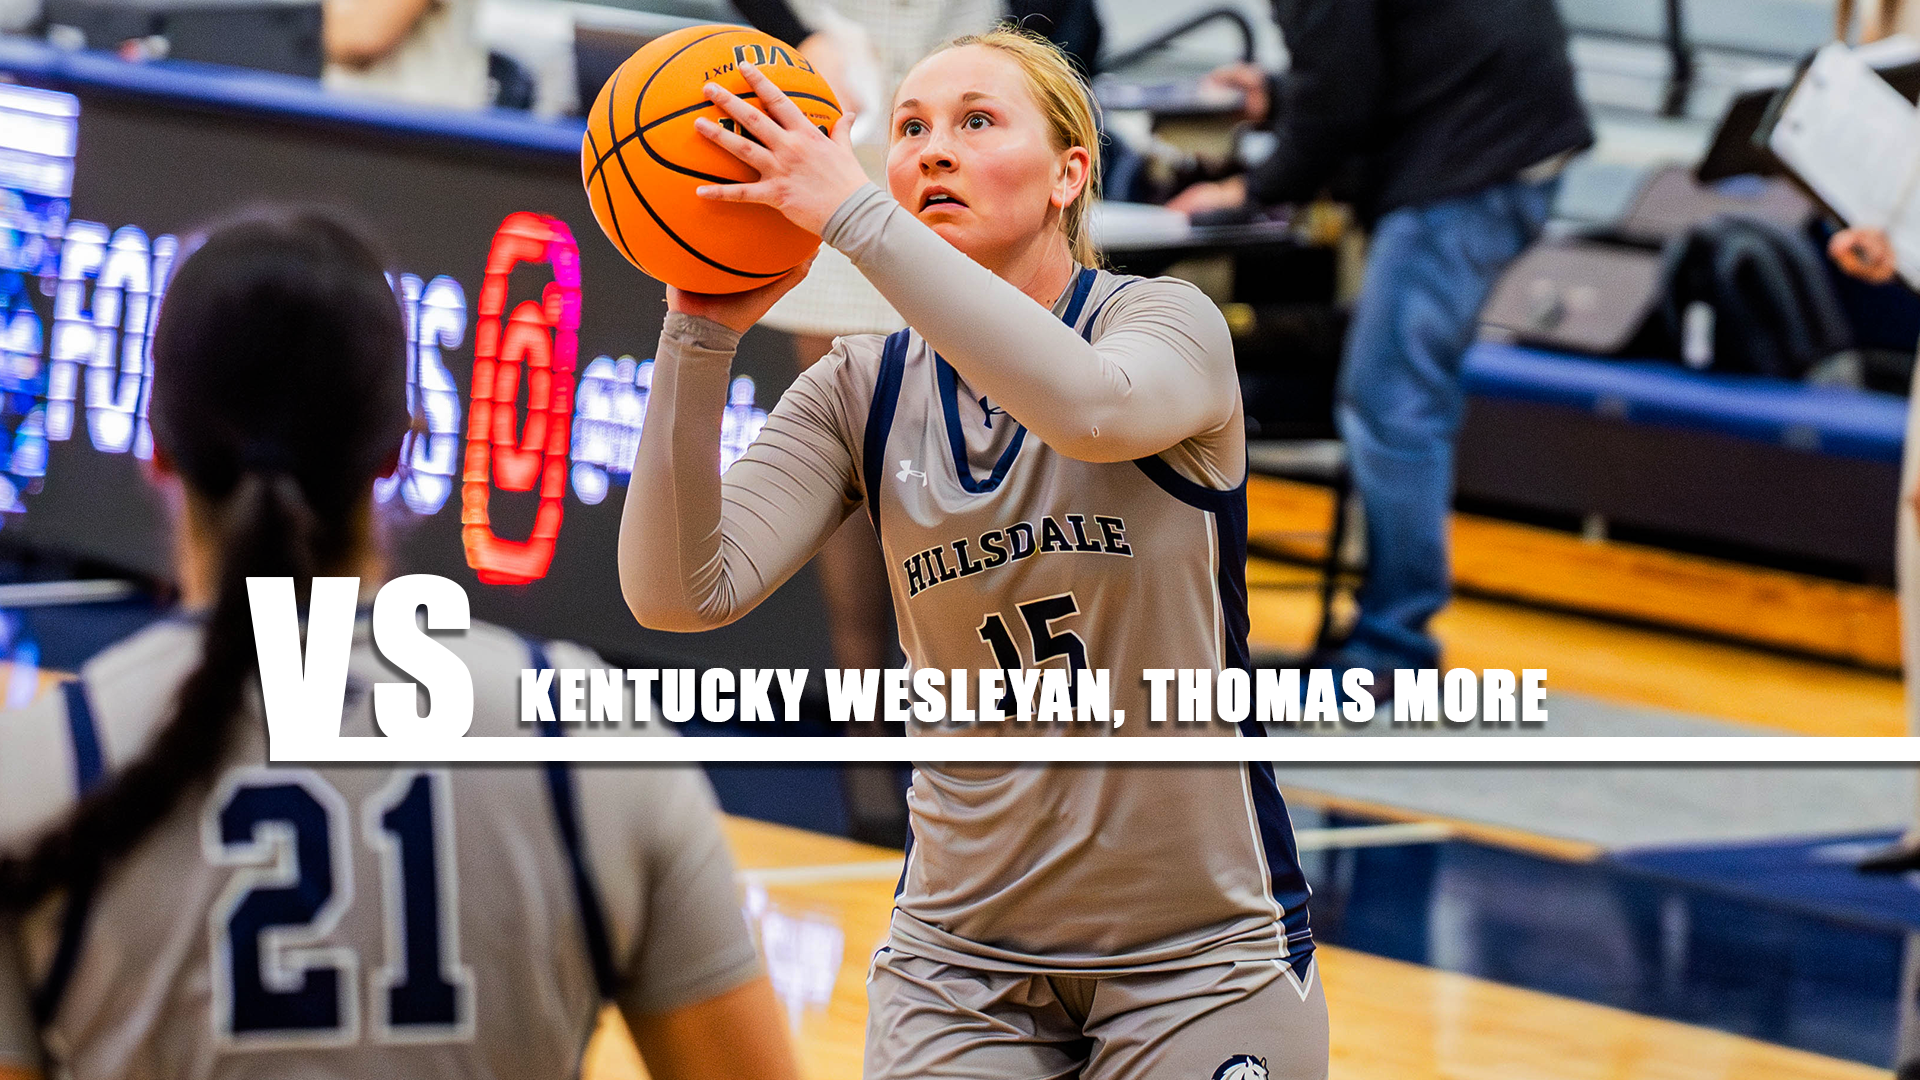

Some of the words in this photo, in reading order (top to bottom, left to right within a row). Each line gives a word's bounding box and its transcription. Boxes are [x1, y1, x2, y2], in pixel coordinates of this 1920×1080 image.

[703, 62, 734, 82] NXT
[732, 44, 815, 75] EVO
[903, 513, 1134, 599] HILLSDALE
[976, 591, 1092, 718] 15
[201, 763, 478, 1049] 21
